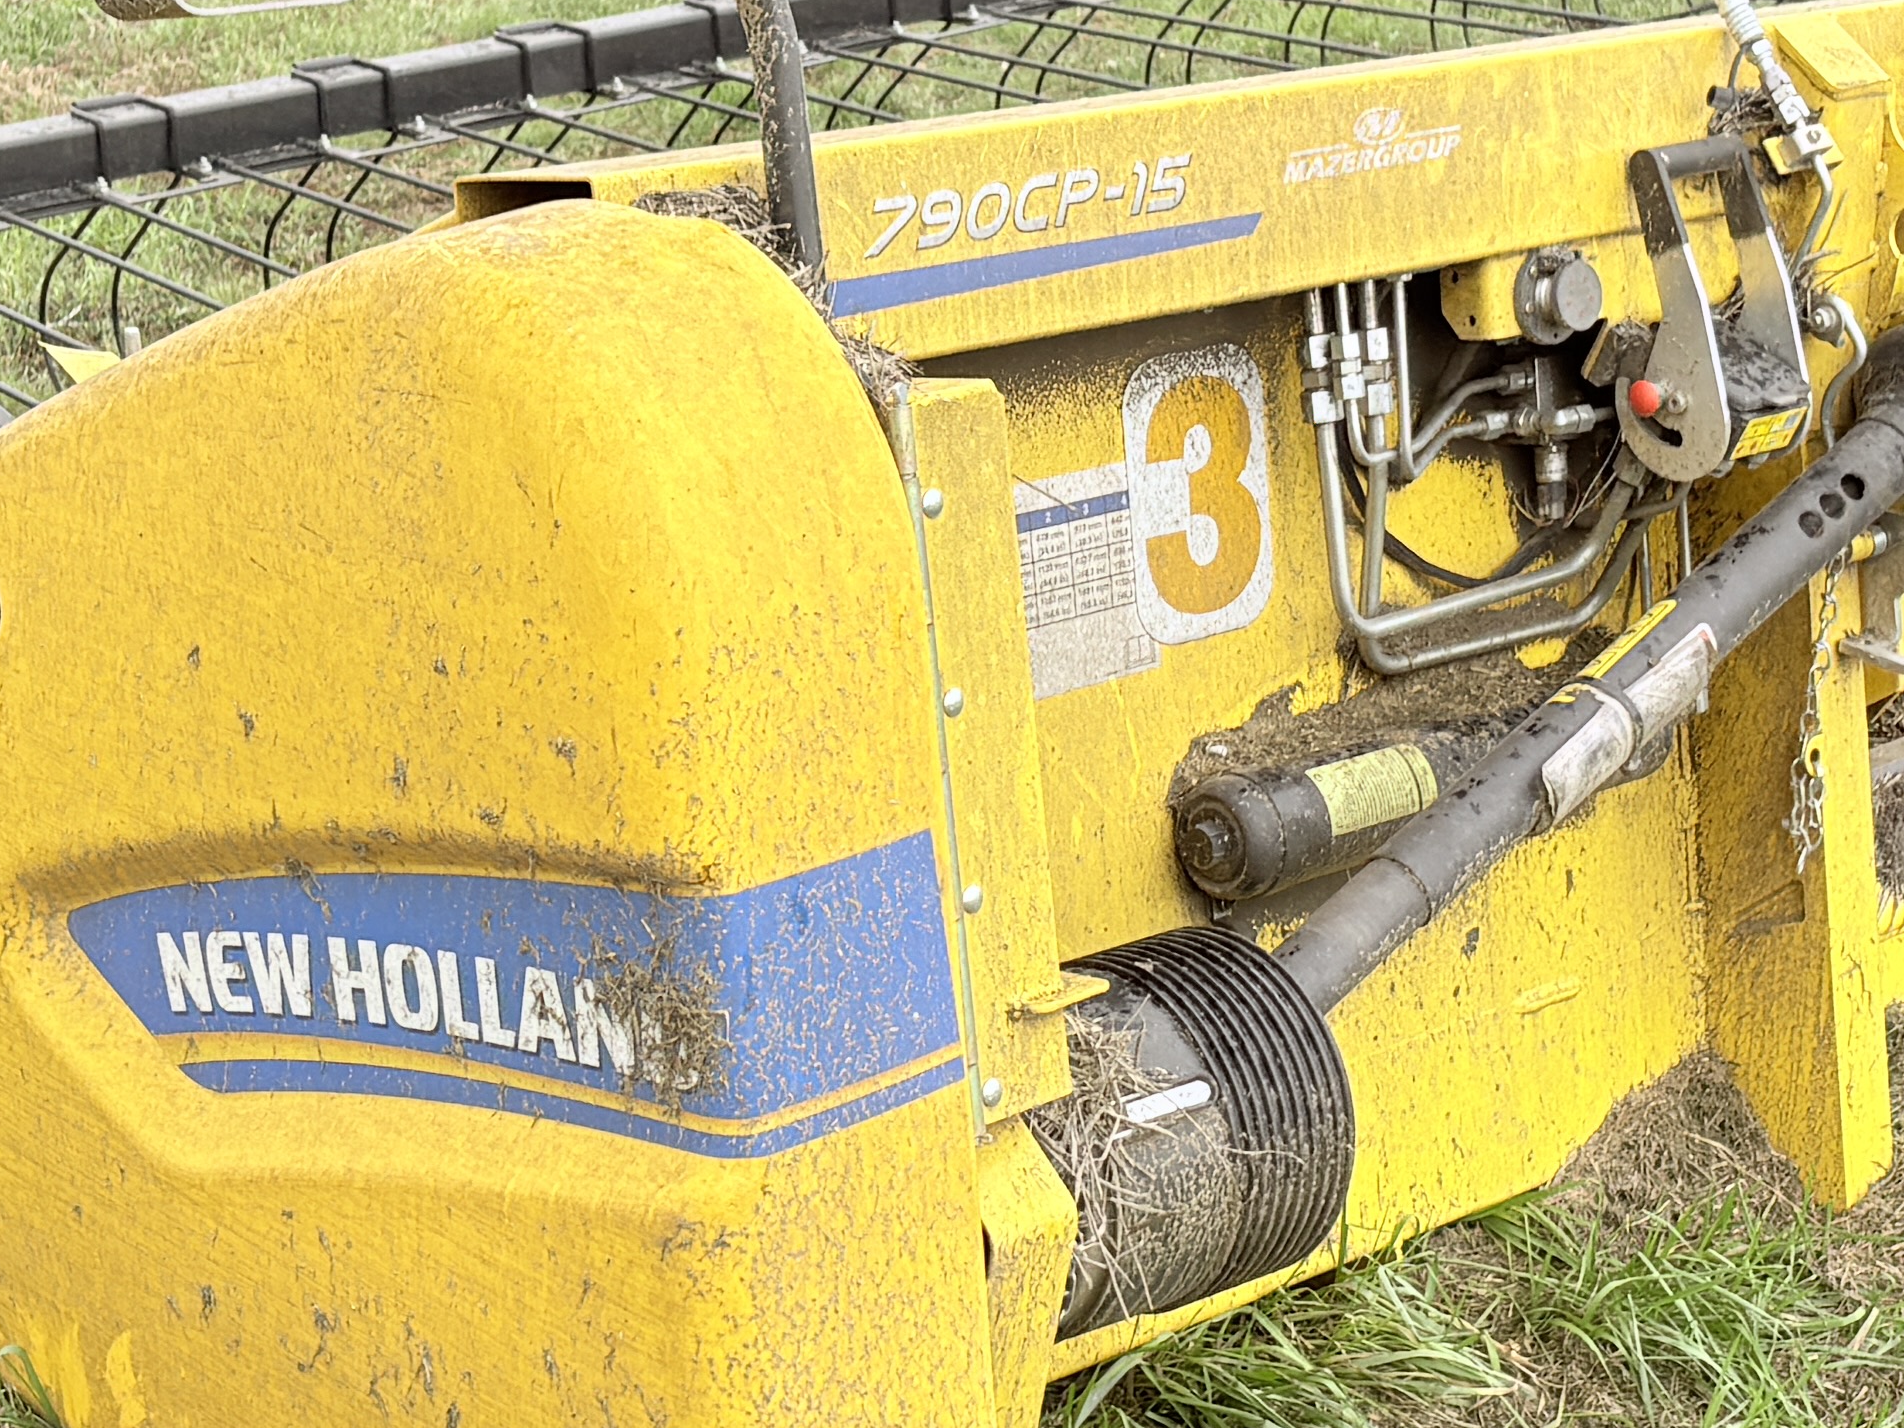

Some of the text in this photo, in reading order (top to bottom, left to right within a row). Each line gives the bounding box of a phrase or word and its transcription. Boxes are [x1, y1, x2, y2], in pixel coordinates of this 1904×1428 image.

[863, 151, 1194, 259] 790CP-15
[1283, 134, 1462, 185] MAZERGROUP
[1145, 375, 1261, 614] 3
[156, 930, 314, 1018] NEW
